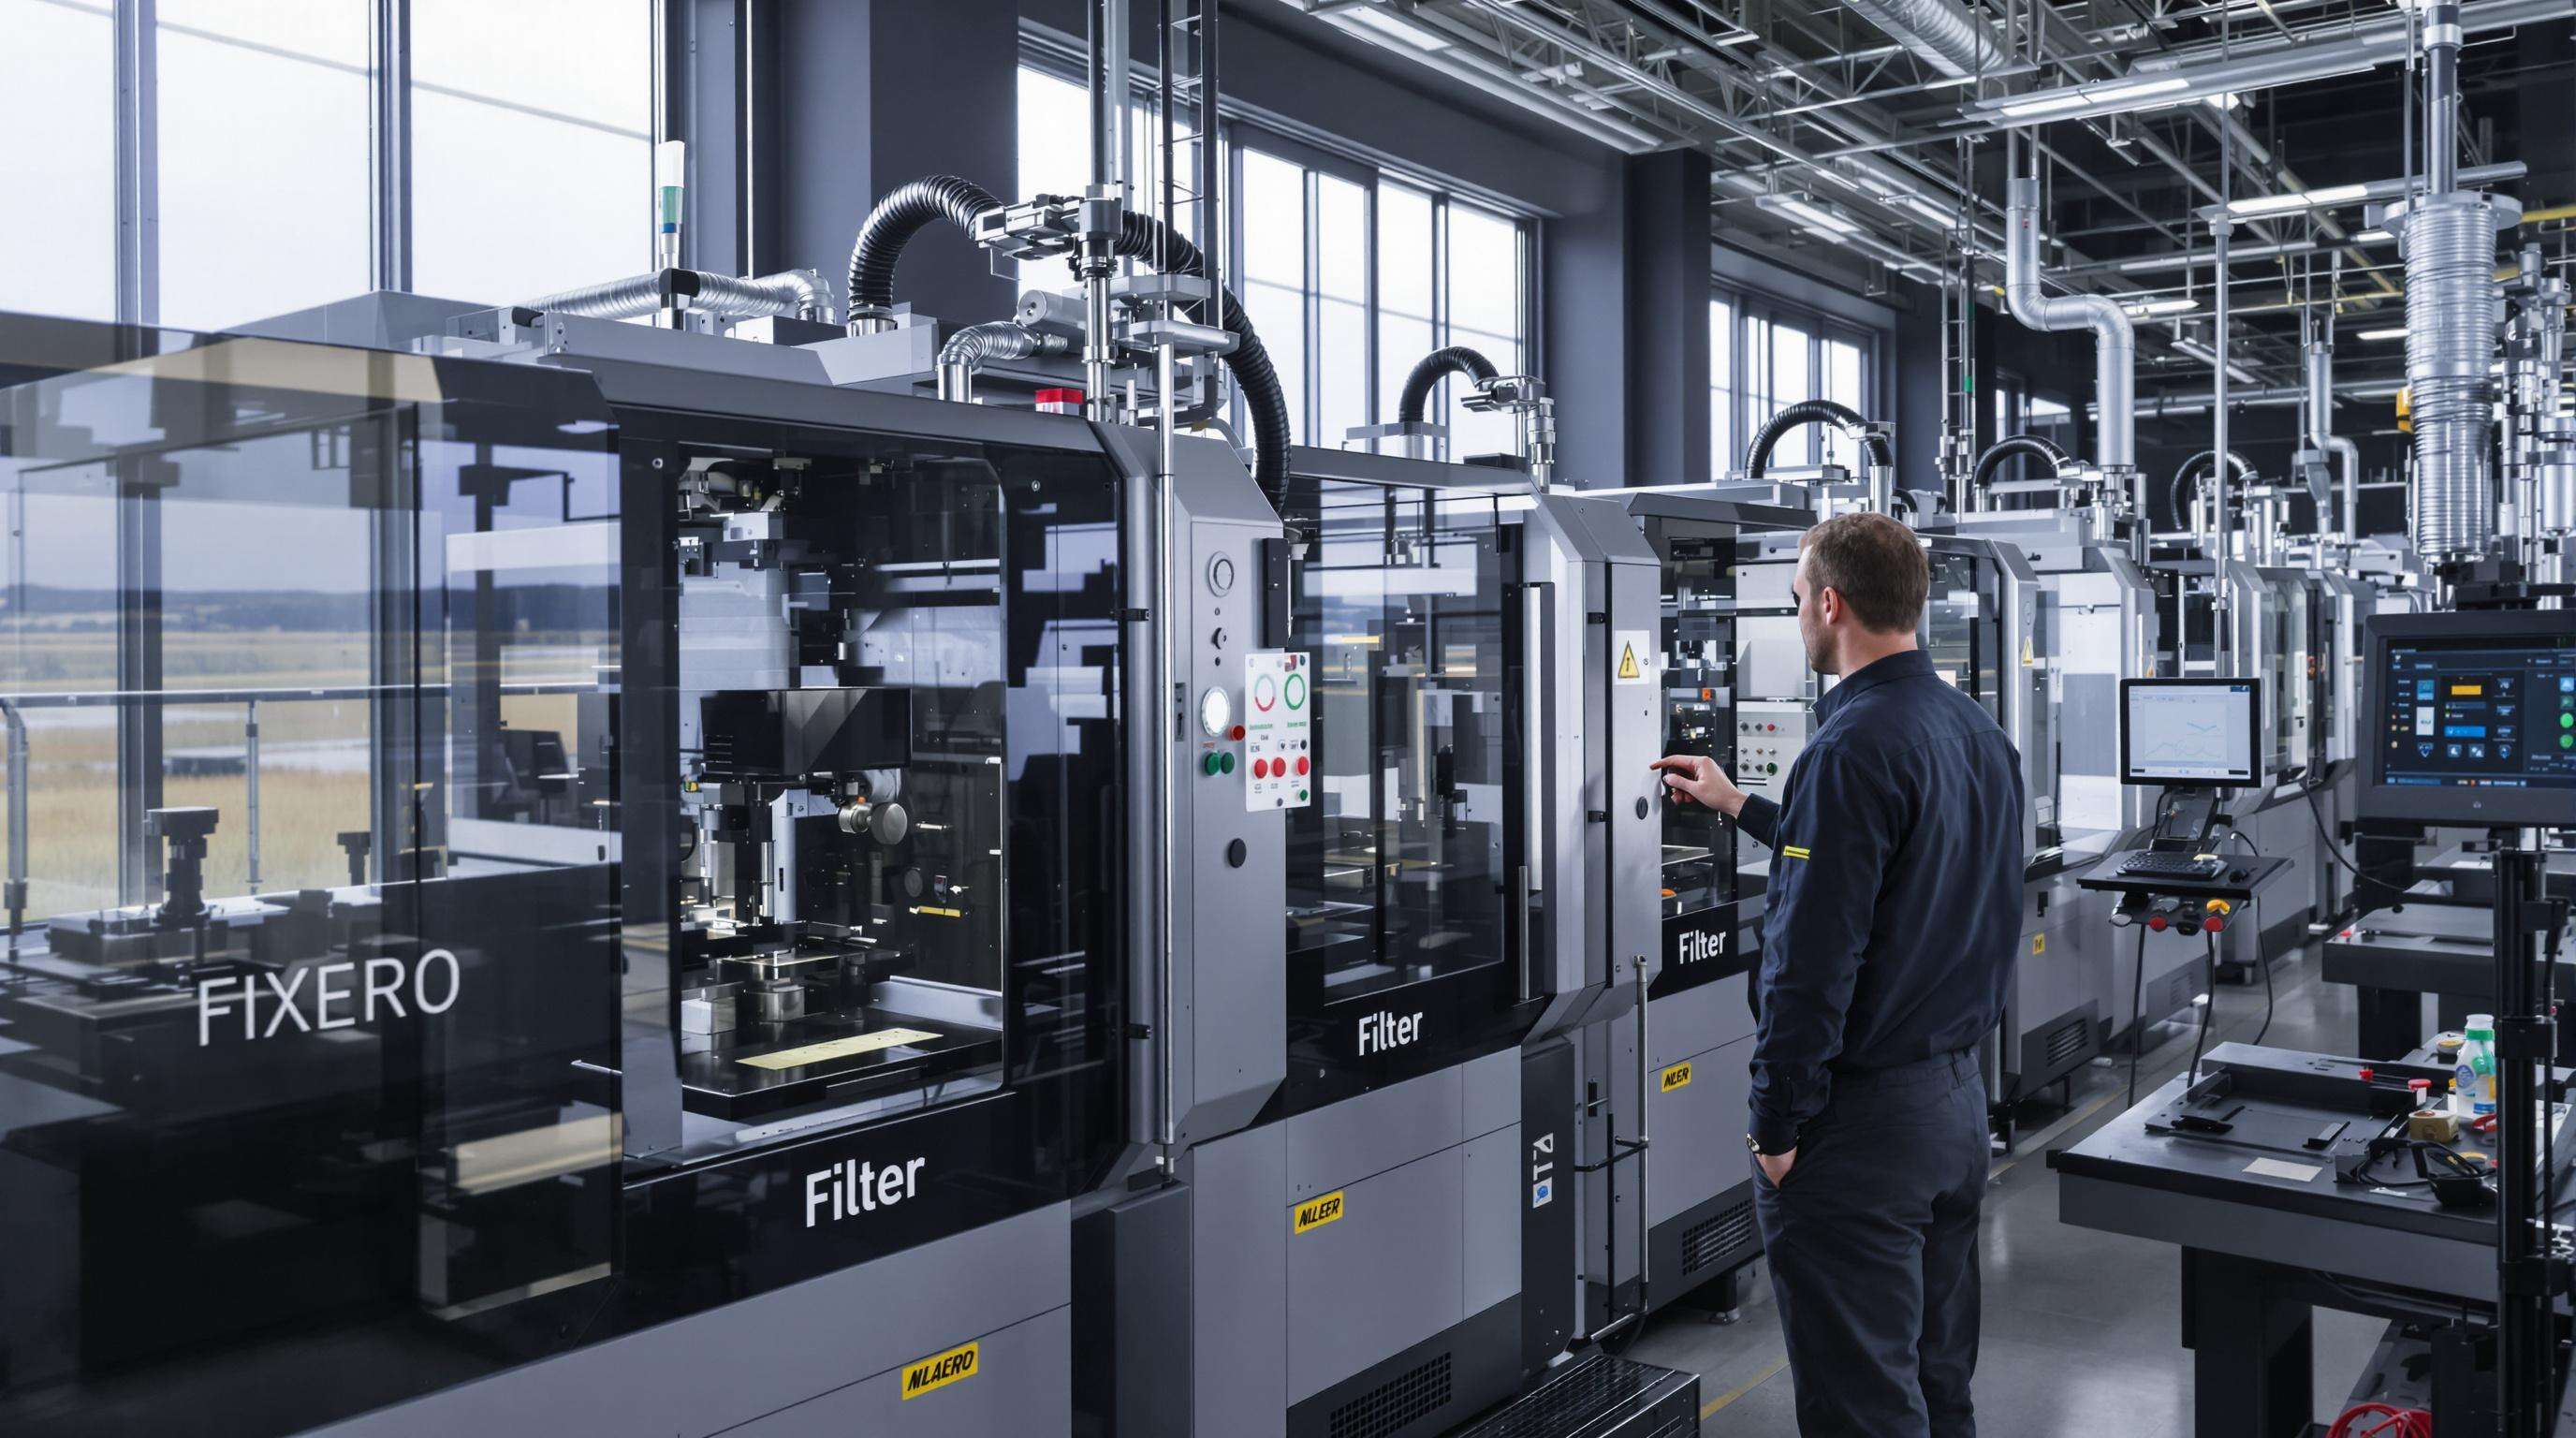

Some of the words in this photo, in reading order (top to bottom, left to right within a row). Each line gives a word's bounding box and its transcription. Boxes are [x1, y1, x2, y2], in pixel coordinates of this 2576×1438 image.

[1678, 929, 1727, 964] Filter
[199, 948, 460, 1047] FIXERO
[1359, 1010, 1423, 1057] Filter
[806, 1156, 926, 1228] Filter
